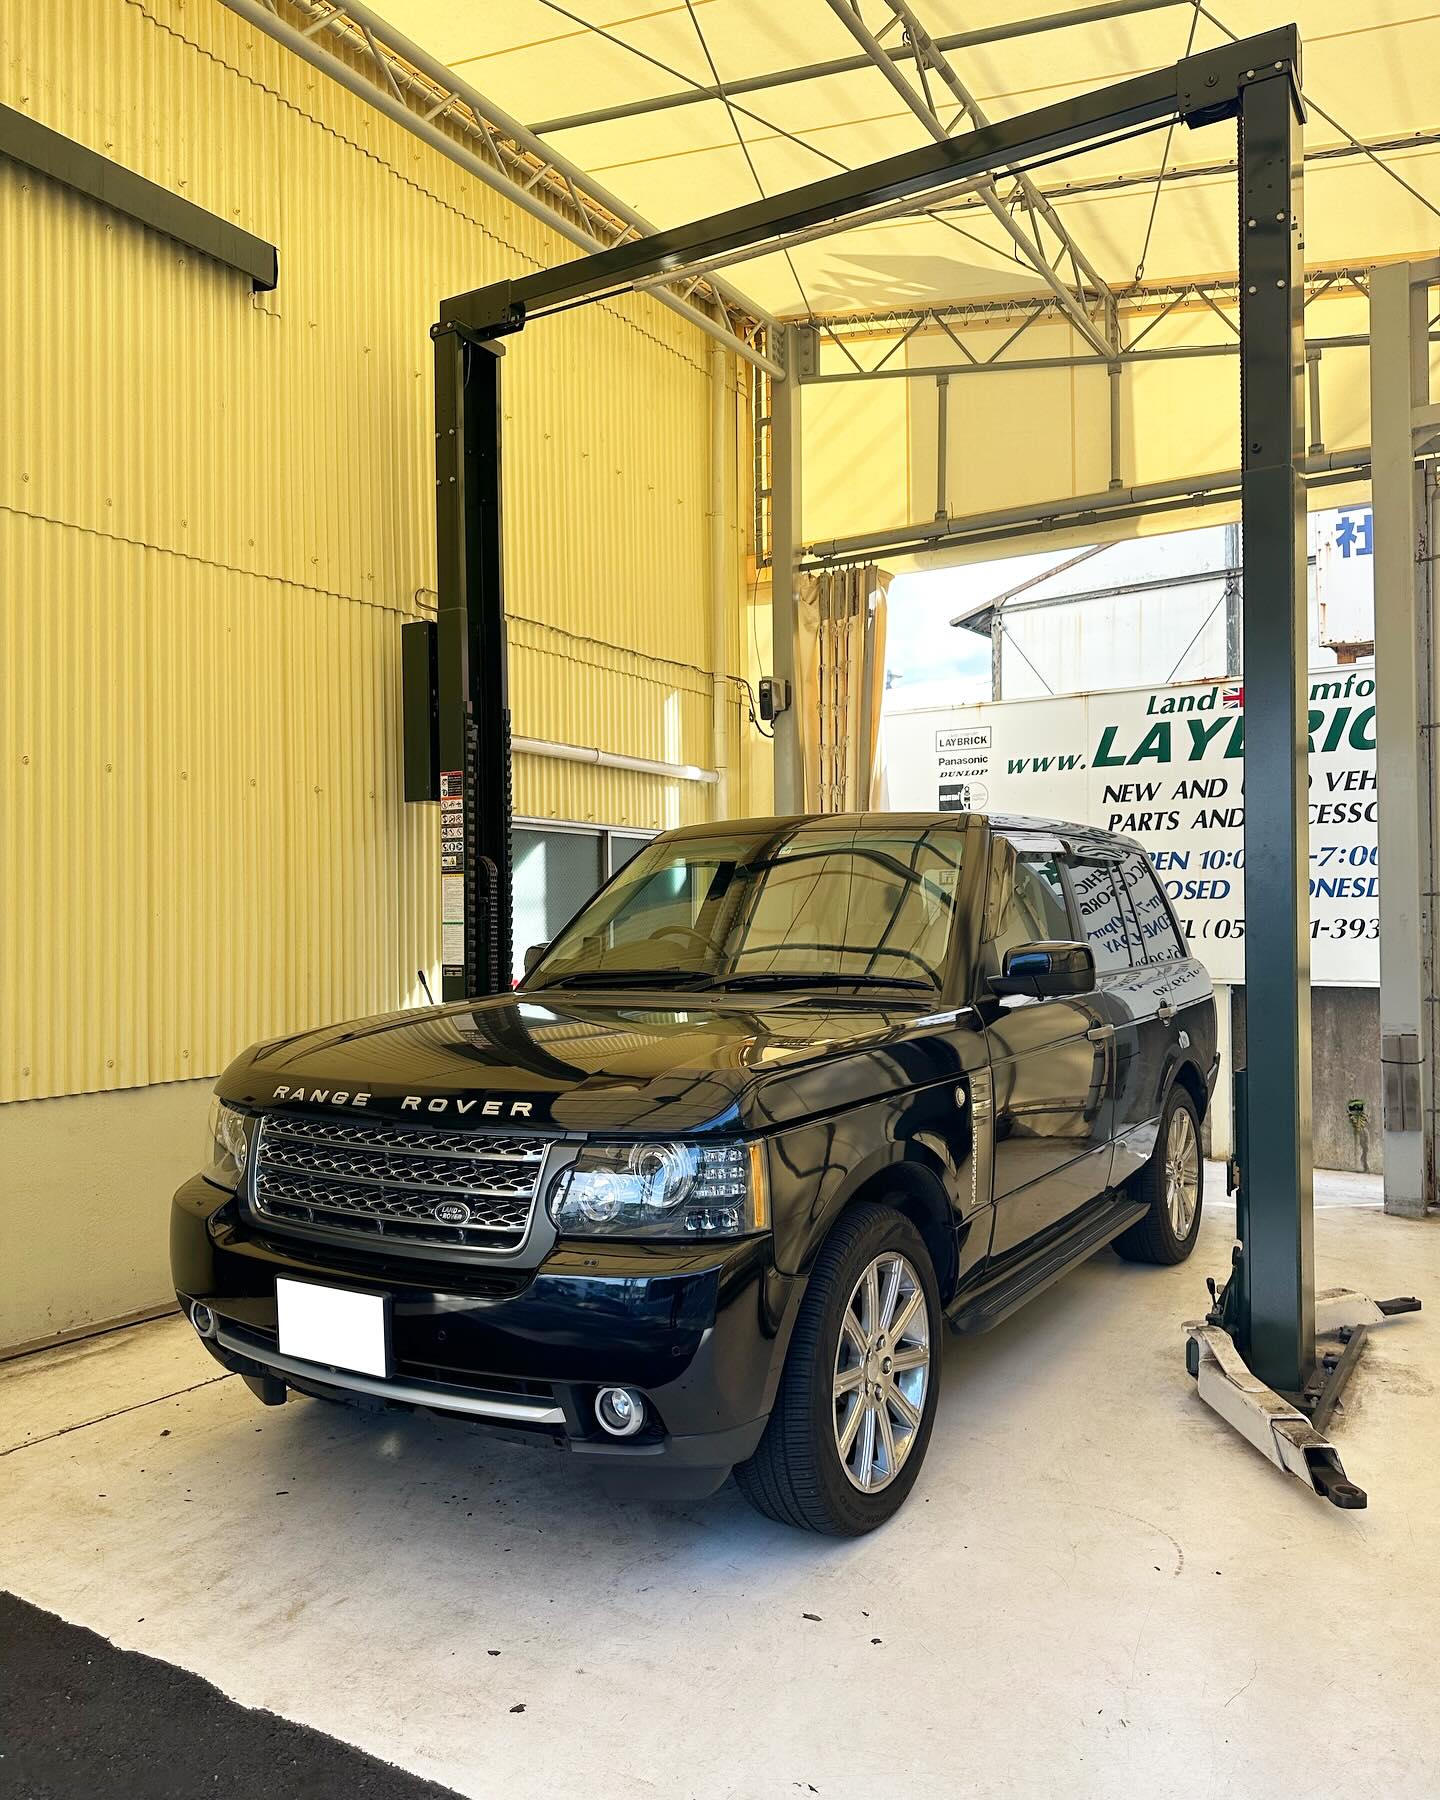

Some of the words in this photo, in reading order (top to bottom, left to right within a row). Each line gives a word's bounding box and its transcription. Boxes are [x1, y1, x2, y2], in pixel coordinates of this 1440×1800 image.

[1146, 687, 1219, 715] Land
[939, 735, 988, 747] LAYBRICK
[938, 755, 989, 766] Panasonic
[940, 769, 989, 778] DUNLOP
[1102, 782, 1162, 804] NEW
[1171, 778, 1228, 800] AND
[1108, 811, 1180, 832] PARTS
[1191, 808, 1244, 829] AND
[1147, 850, 1190, 871] PEN
[1164, 880, 1231, 900] OSED
[272, 1085, 372, 1107] RANGE
[400, 1096, 533, 1117] ROVER
